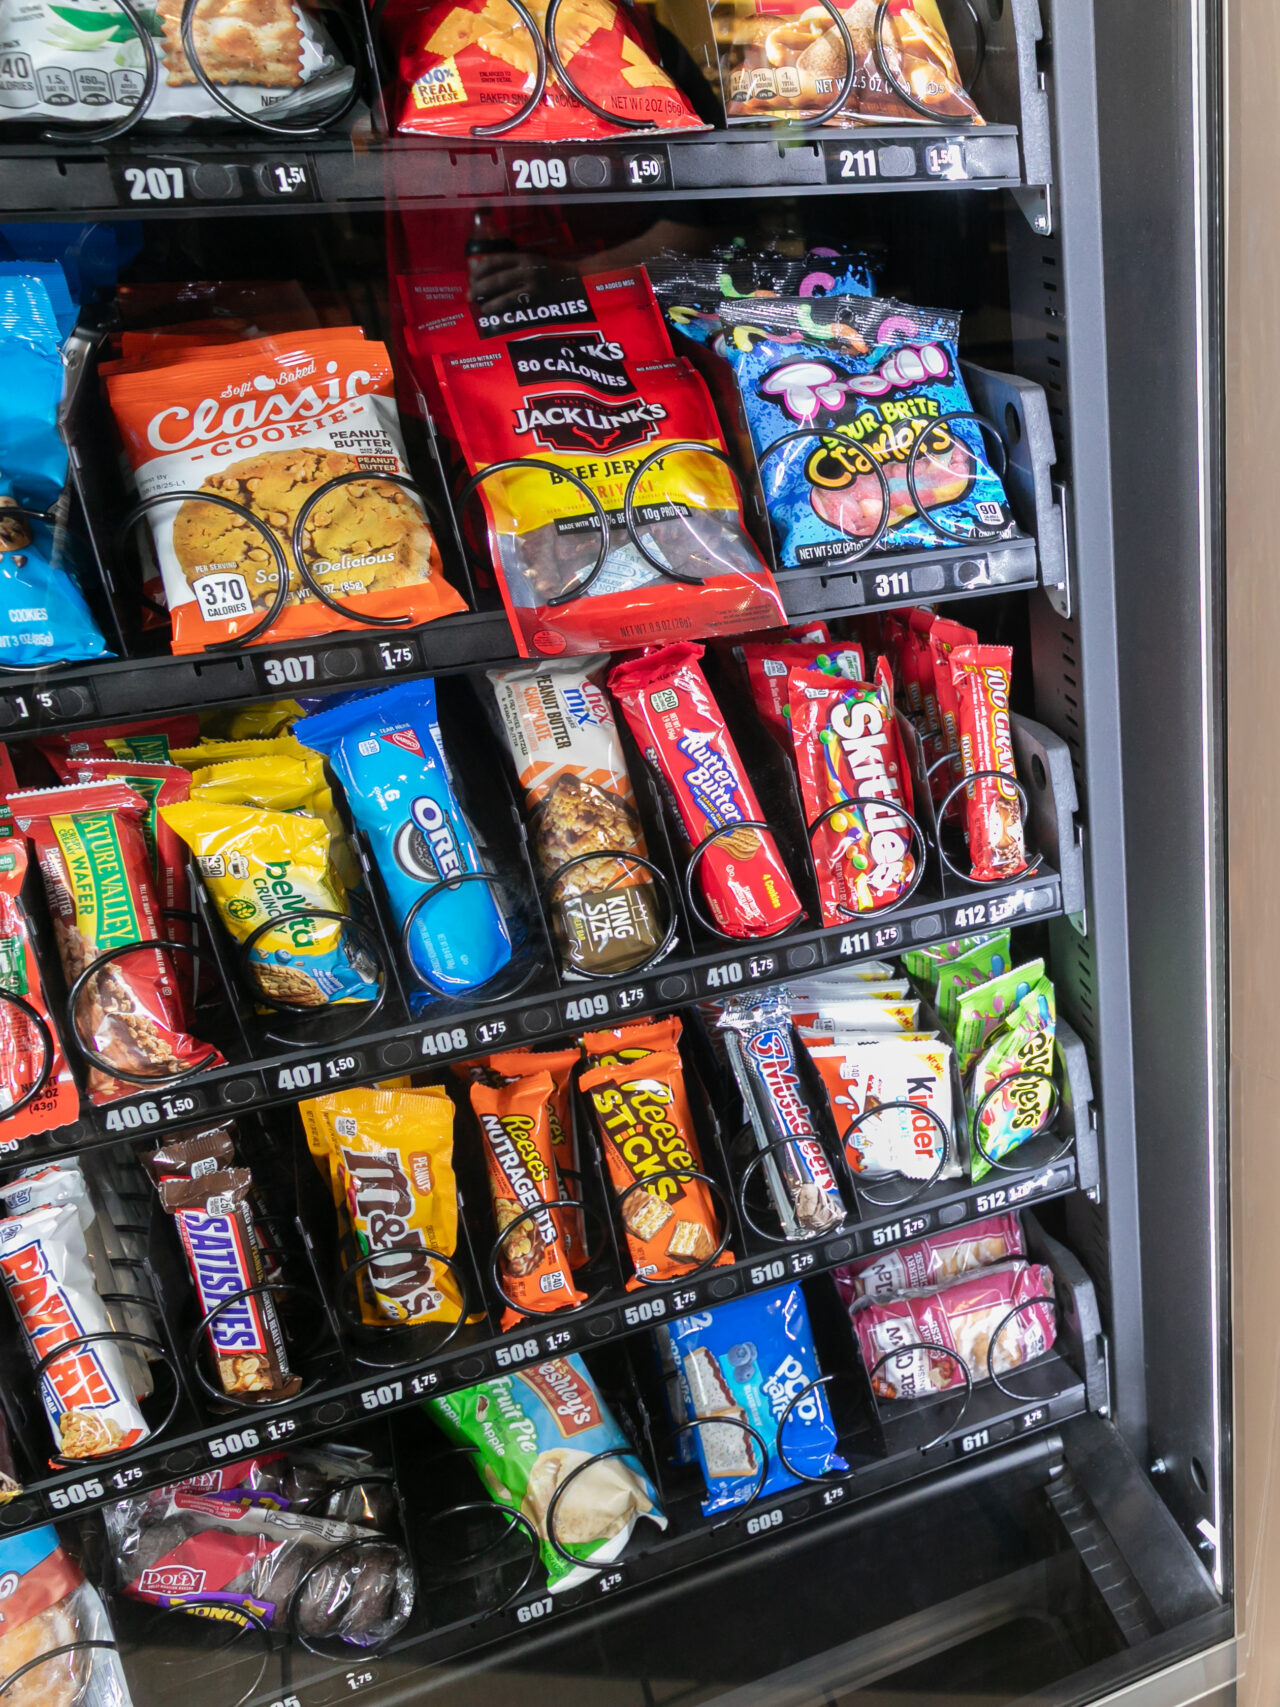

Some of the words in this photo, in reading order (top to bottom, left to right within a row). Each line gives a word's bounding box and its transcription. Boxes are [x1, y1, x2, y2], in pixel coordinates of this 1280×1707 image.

[418, 83, 454, 97] REAL
[422, 92, 460, 105] CHEESE
[513, 159, 567, 189] 209
[629, 160, 660, 184] 1.50
[840, 150, 876, 177] 211
[124, 167, 185, 200] 207
[478, 315, 500, 328] 80
[503, 299, 588, 324] CALORIES
[220, 382, 253, 399] Soft
[276, 360, 316, 386] Baked
[517, 360, 540, 373] 80
[543, 358, 628, 387] CALORIES
[147, 361, 372, 452] Classic
[513, 406, 585, 434] JACK
[583, 403, 668, 430] LINK'S
[210, 409, 347, 457] COOKIE
[329, 430, 388, 440] PEANUT
[334, 439, 392, 449] BUTTER
[822, 411, 879, 449] SOUR
[357, 457, 395, 466] PEANUT
[359, 463, 397, 472] BUTTER
[980, 503, 997, 516] 90
[312, 552, 395, 577] Delicious
[201, 579, 244, 606] 370
[875, 573, 910, 597] 311
[8, 607, 48, 622] COOKIES
[207, 602, 247, 617] CALORIES
[264, 655, 316, 686] 307
[381, 648, 413, 671] 1.75
[581, 680, 613, 726] Chex
[660, 689, 677, 709] 260
[980, 666, 1009, 711] 100
[523, 686, 552, 742] CHOCOLATE
[536, 674, 557, 714] PEANUT
[549, 711, 572, 750] BUTTER
[563, 688, 598, 727] mix
[680, 730, 738, 793] Nutter
[991, 709, 1019, 800] GRAND
[686, 768, 742, 825] Butter
[829, 701, 906, 892] Skittles
[71, 855, 94, 916] WAFER
[762, 873, 771, 883] 4
[764, 880, 781, 909] Cookies
[100, 874, 136, 940] VALLEY
[584, 902, 609, 942] SIZE
[605, 894, 635, 940] KING
[955, 905, 986, 927] 412
[840, 932, 870, 955] 411
[875, 927, 897, 947] 1.75
[706, 963, 743, 987] 410
[750, 958, 773, 978] 1.75
[565, 994, 609, 1022] 409
[619, 988, 645, 1008] 1.75
[421, 1028, 468, 1056] 408
[480, 1021, 506, 1042] 1.75
[749, 1030, 785, 1058] 3
[278, 1063, 323, 1091] 407
[326, 1057, 355, 1078] 1.50
[29, 1100, 57, 1115] (43g)
[106, 1102, 160, 1131] 406
[162, 1097, 194, 1119] 1.50
[501, 1115, 549, 1181] Reese's
[620, 1079, 698, 1183] Reese's
[412, 1155, 430, 1193] PEANUT
[977, 1191, 1006, 1212] 512
[872, 1223, 901, 1246] 511
[904, 1221, 925, 1238] 1.75
[751, 1259, 786, 1285] 510
[791, 1254, 814, 1272] 1.75
[625, 1298, 666, 1325] 509
[673, 1292, 696, 1310] 1.75
[495, 1339, 539, 1366] 508
[547, 1331, 571, 1350] 1.75
[361, 1382, 403, 1410] 507
[411, 1374, 437, 1394] 1.75
[487, 1375, 524, 1430] Fruit
[510, 1416, 538, 1453] Pie
[963, 1431, 990, 1450] 611
[1024, 1411, 1041, 1427] 1.75
[208, 1429, 259, 1459] 506
[267, 1420, 295, 1440] 1.75
[482, 1420, 505, 1456] Apple
[49, 1479, 104, 1510] 505
[113, 1467, 143, 1489] 1.75
[747, 1509, 783, 1534] 609
[824, 1488, 844, 1505] 1.75
[146, 1571, 199, 1588] DOLLY
[517, 1598, 553, 1623] 607
[600, 1573, 622, 1592] 1.75
[348, 1672, 372, 1690] 1.75
